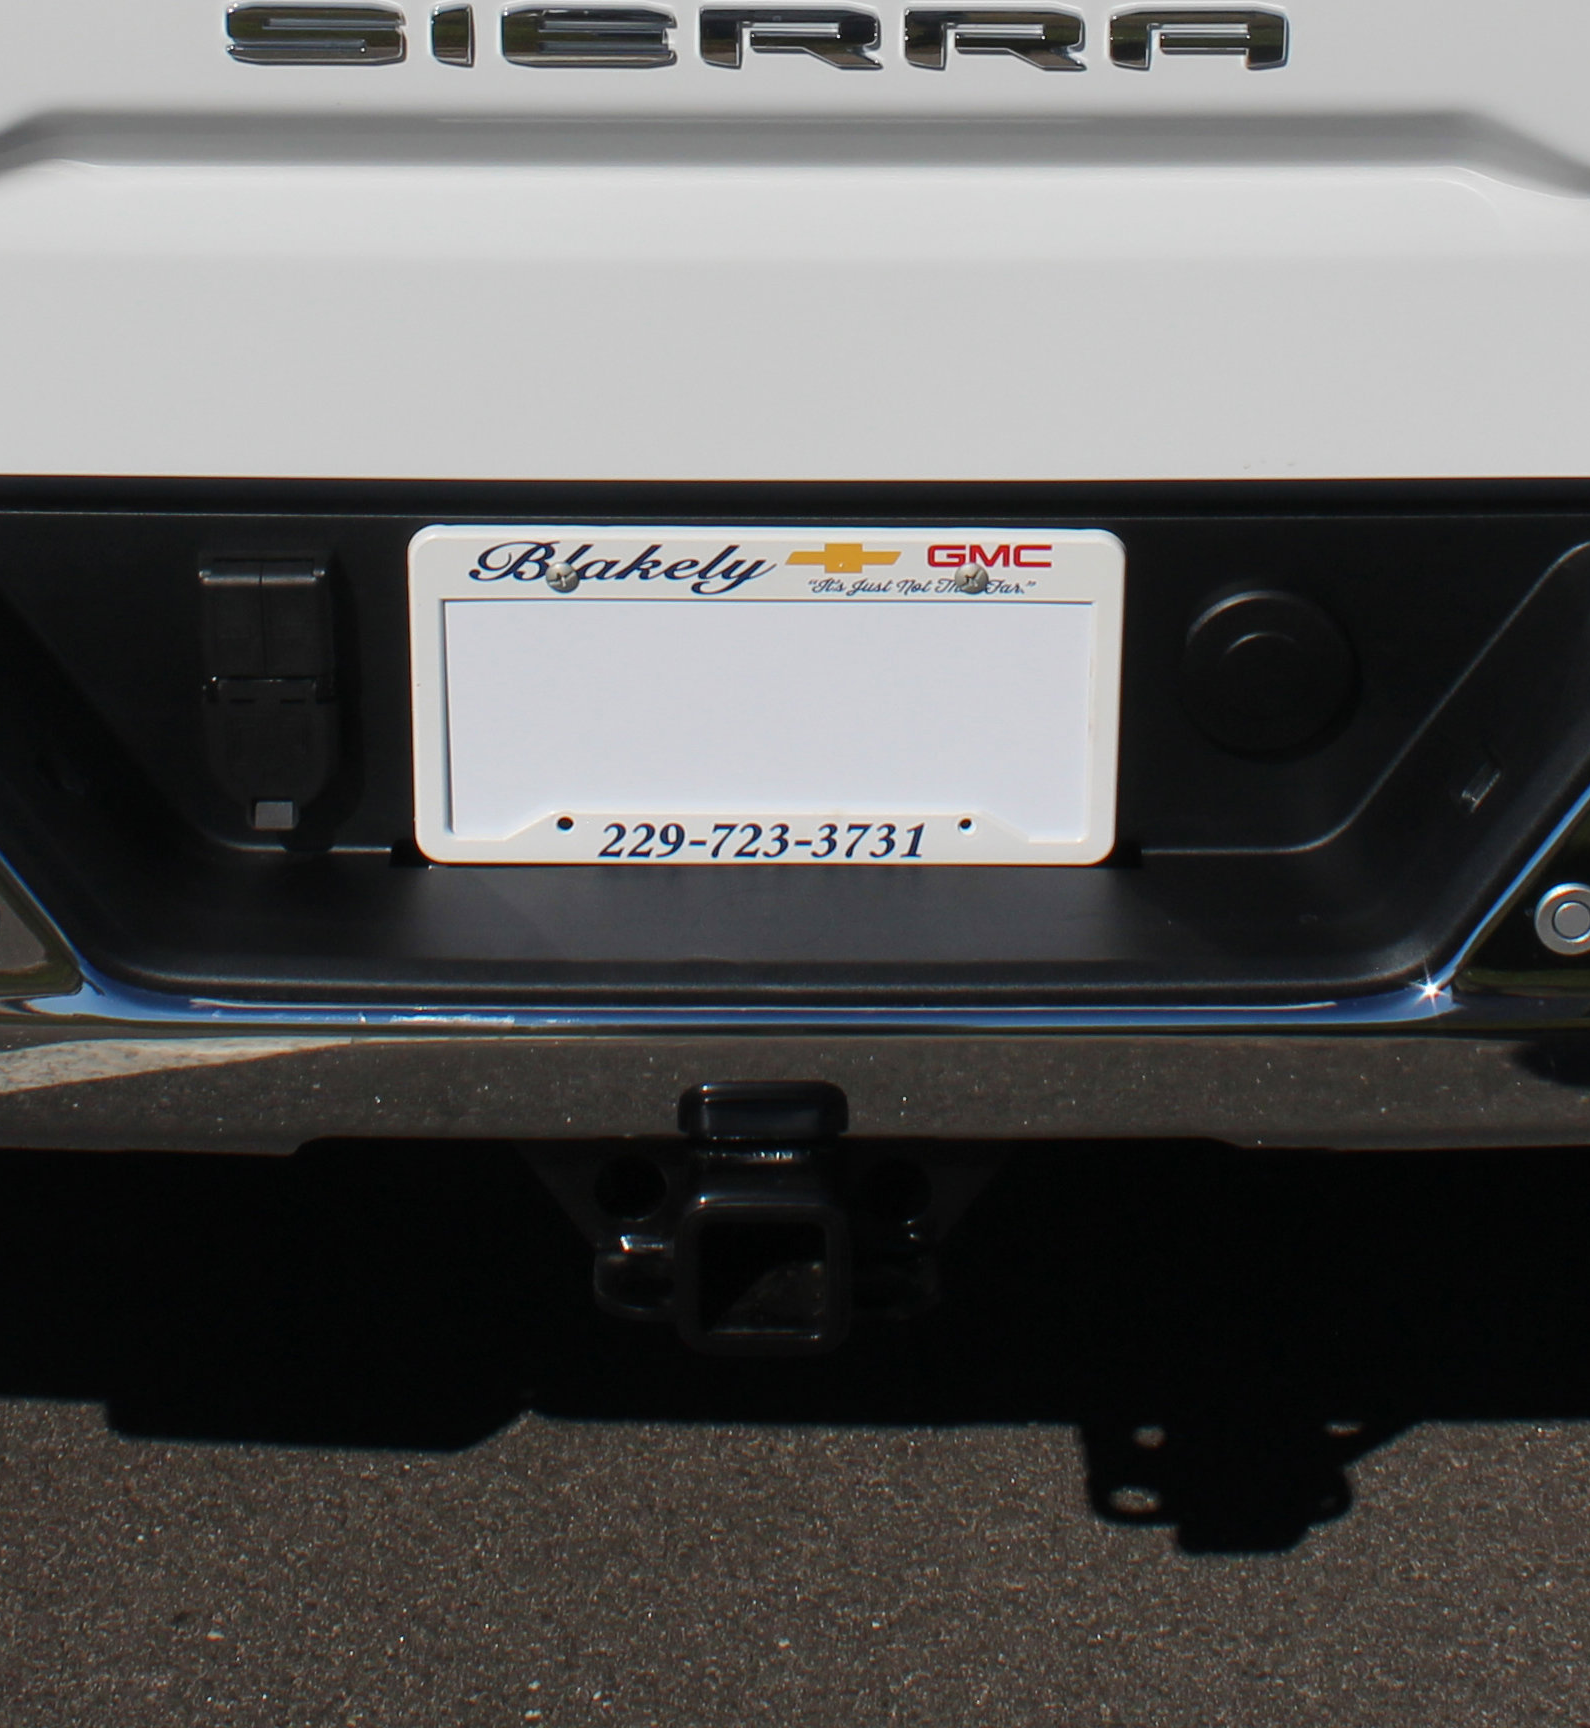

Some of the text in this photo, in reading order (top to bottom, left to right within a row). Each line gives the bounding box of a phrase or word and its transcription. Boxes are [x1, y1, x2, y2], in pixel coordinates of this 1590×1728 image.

[224, 0, 1290, 72] SIERRA
[927, 544, 1053, 568] GMC
[846, 578, 893, 597] Just
[896, 579, 932, 594] Not
[598, 823, 927, 860] 229-723-3731
